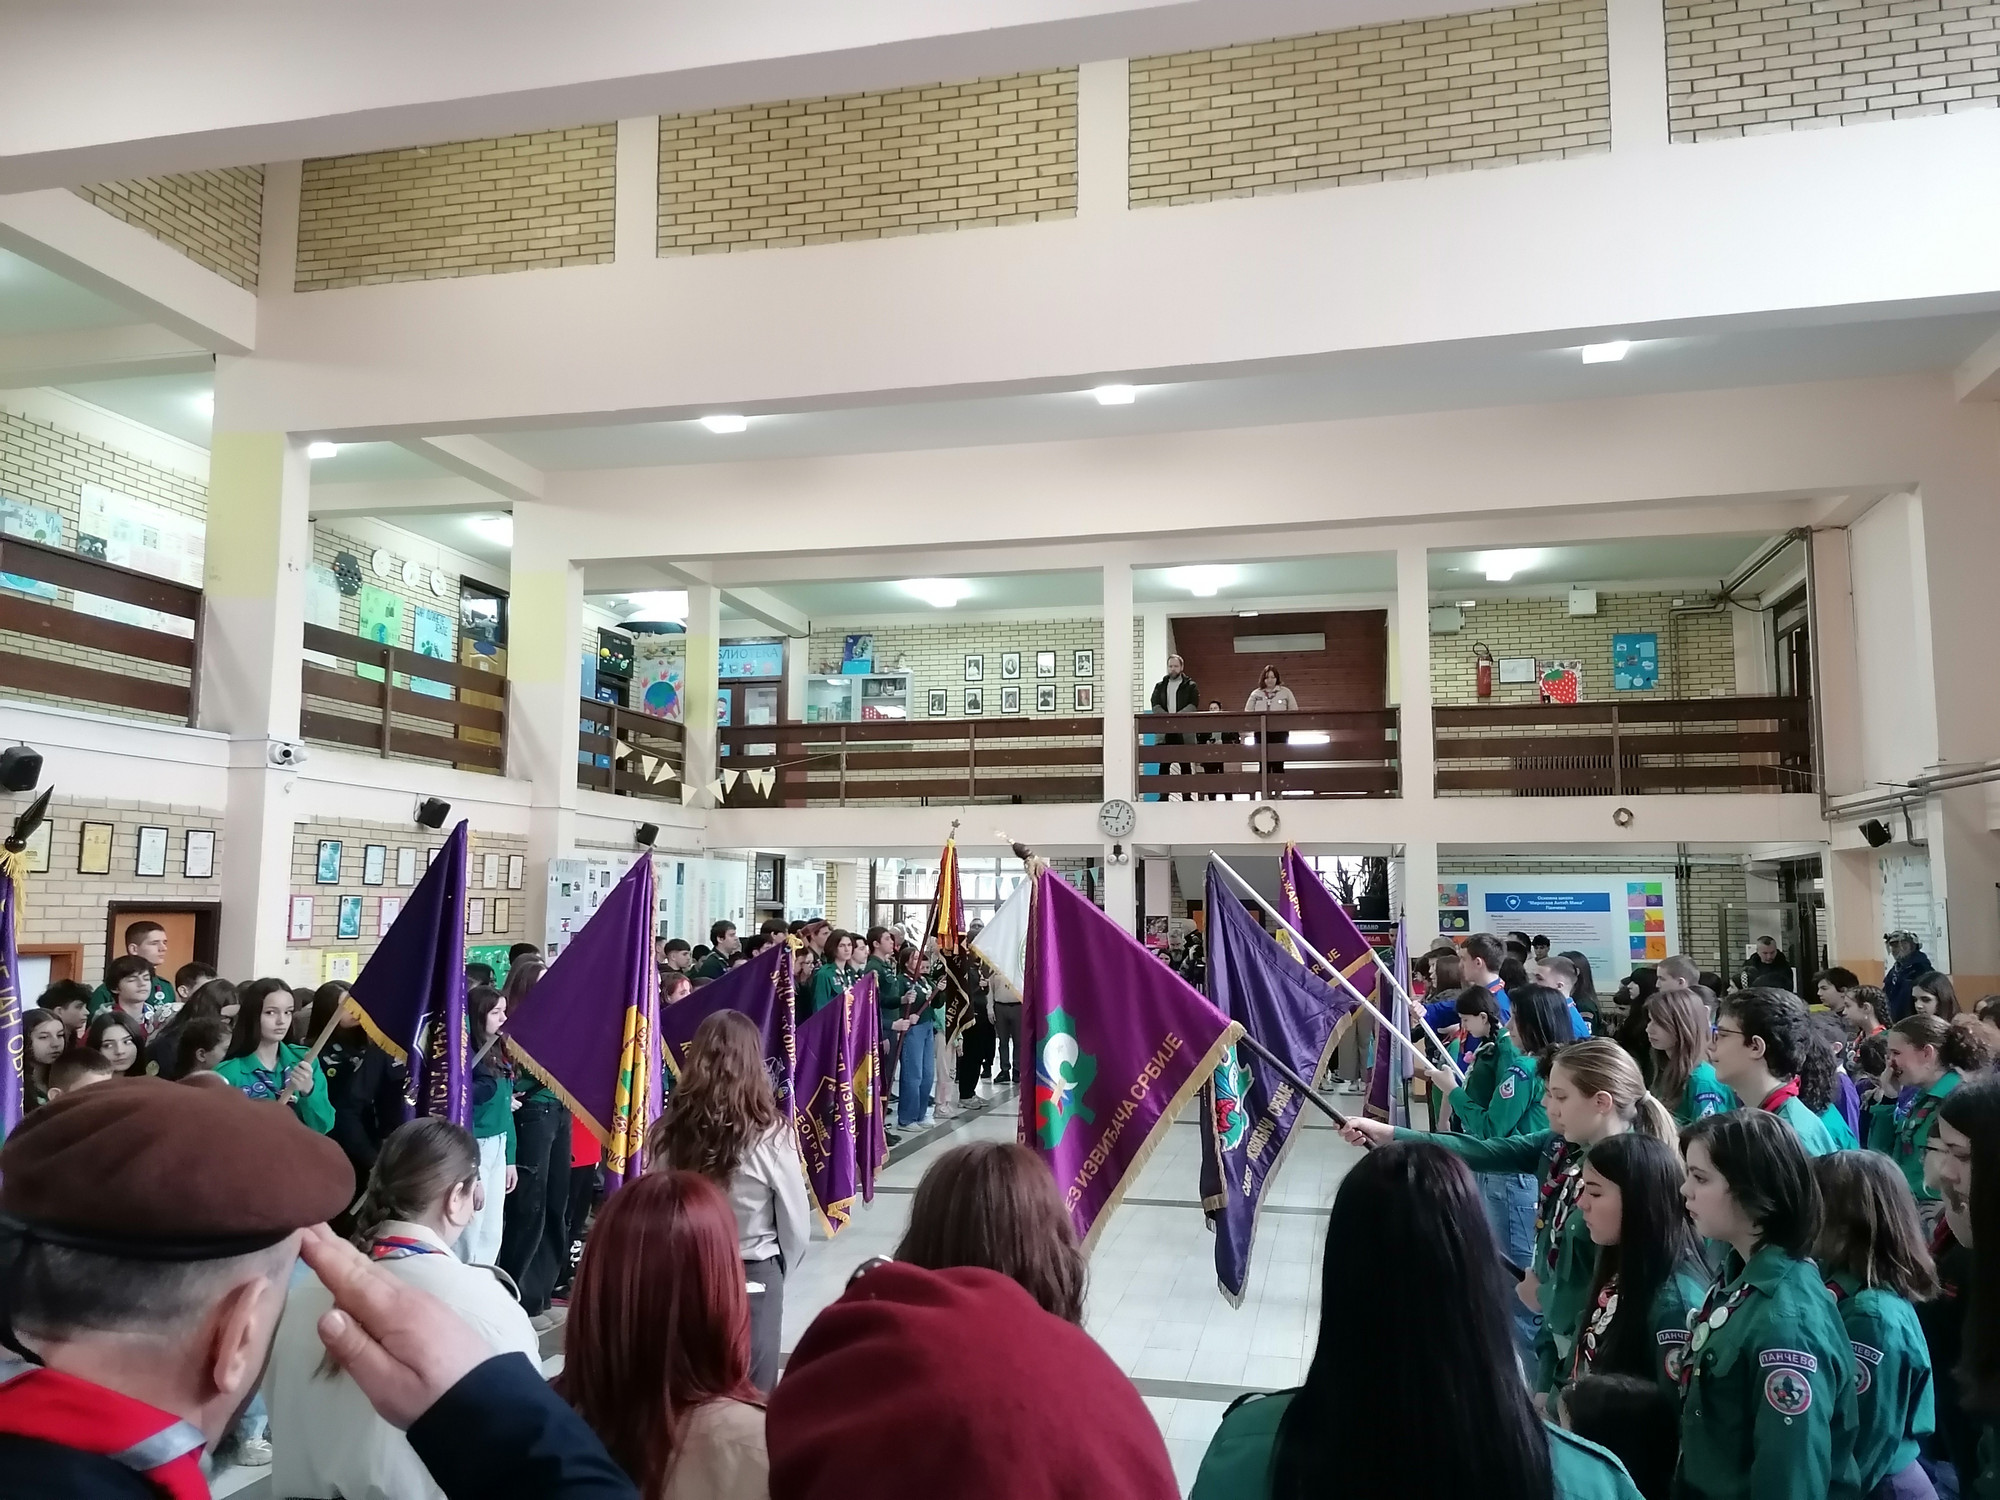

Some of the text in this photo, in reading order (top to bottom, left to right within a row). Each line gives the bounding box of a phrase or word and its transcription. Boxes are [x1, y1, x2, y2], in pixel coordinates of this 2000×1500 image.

[1075, 1099, 1139, 1188] ИЗВИЂАЧА
[1130, 1031, 1184, 1100] СРБИЈЕ
[1266, 1081, 1295, 1117] СРБИЈЕ
[1659, 1332, 1689, 1341] ПАНЧЕ
[1760, 1351, 1816, 1368] ПАНЧЕВО
